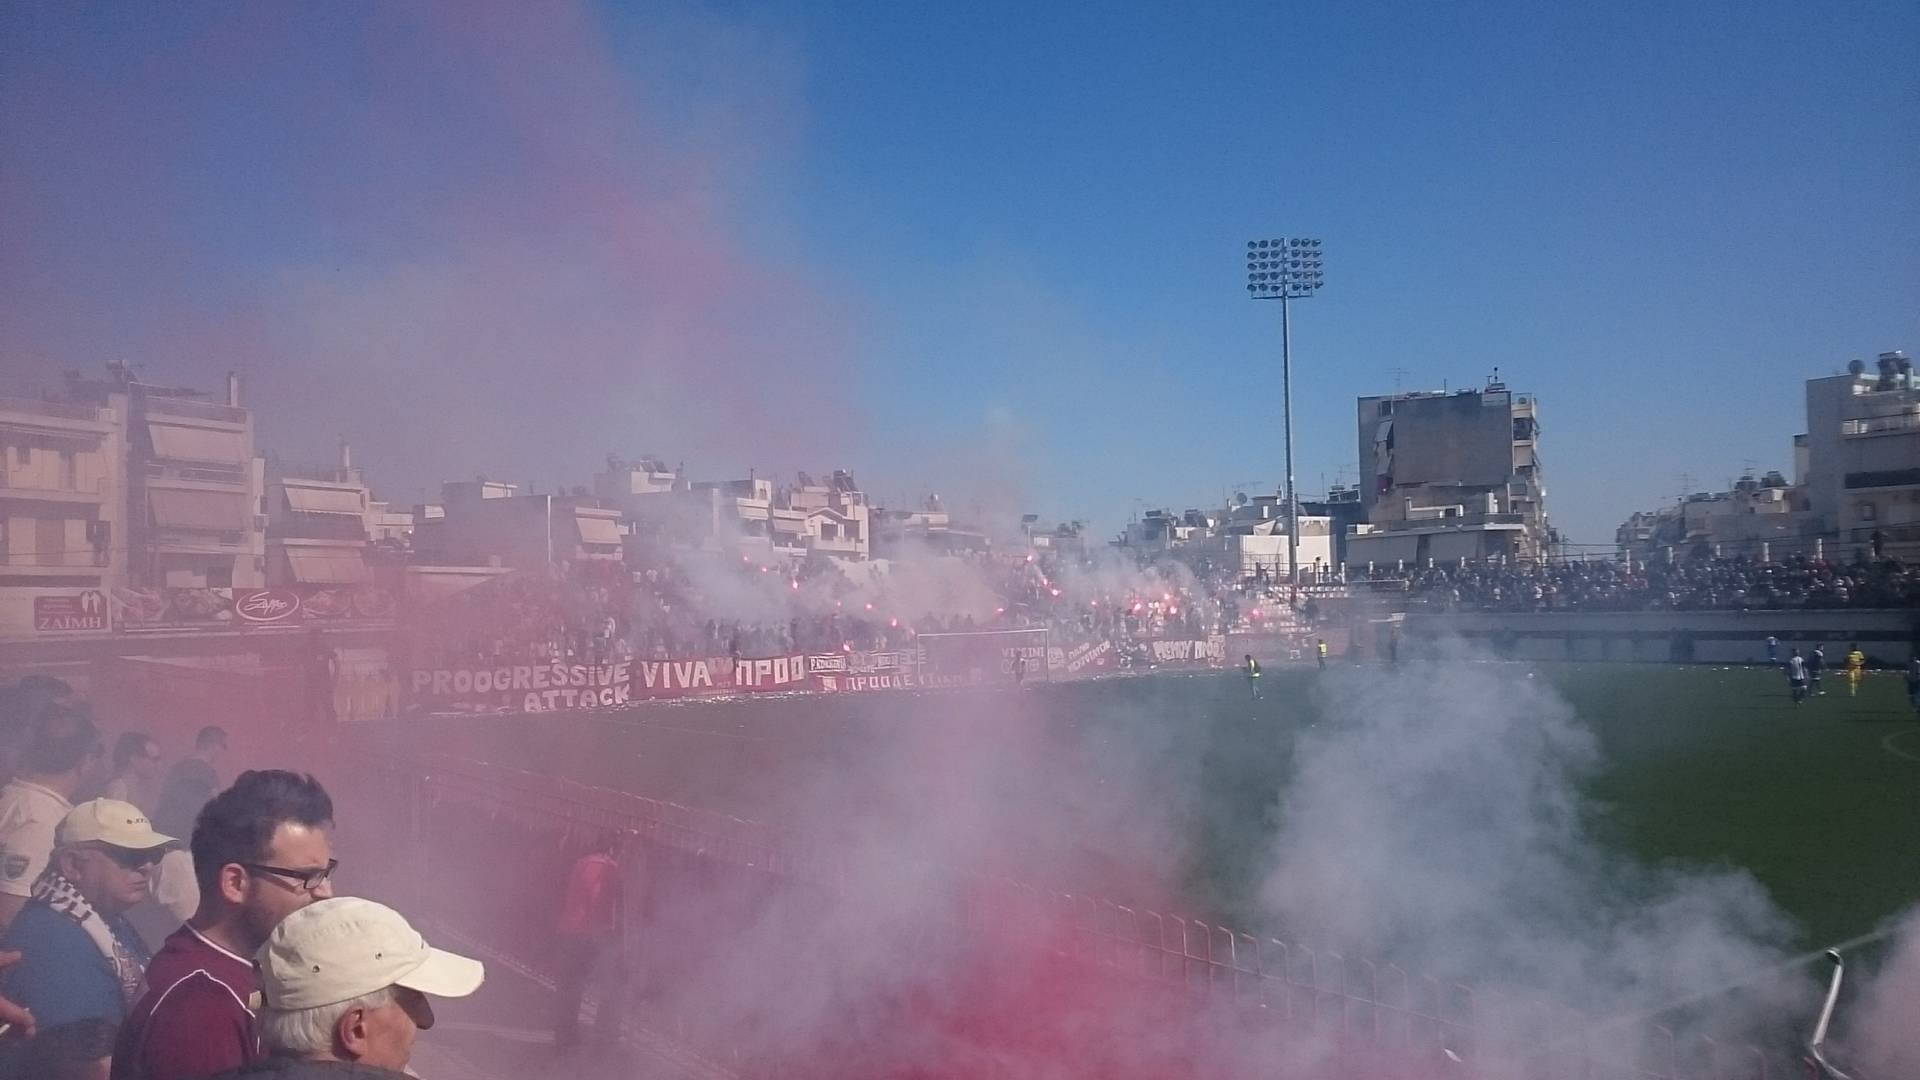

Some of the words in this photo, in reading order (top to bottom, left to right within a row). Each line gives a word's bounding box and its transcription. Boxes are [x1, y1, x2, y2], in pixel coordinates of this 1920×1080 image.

[411, 662, 632, 696] PROOGRESSIVE
[641, 660, 713, 688] VIVA
[524, 683, 631, 713] ATTACK
